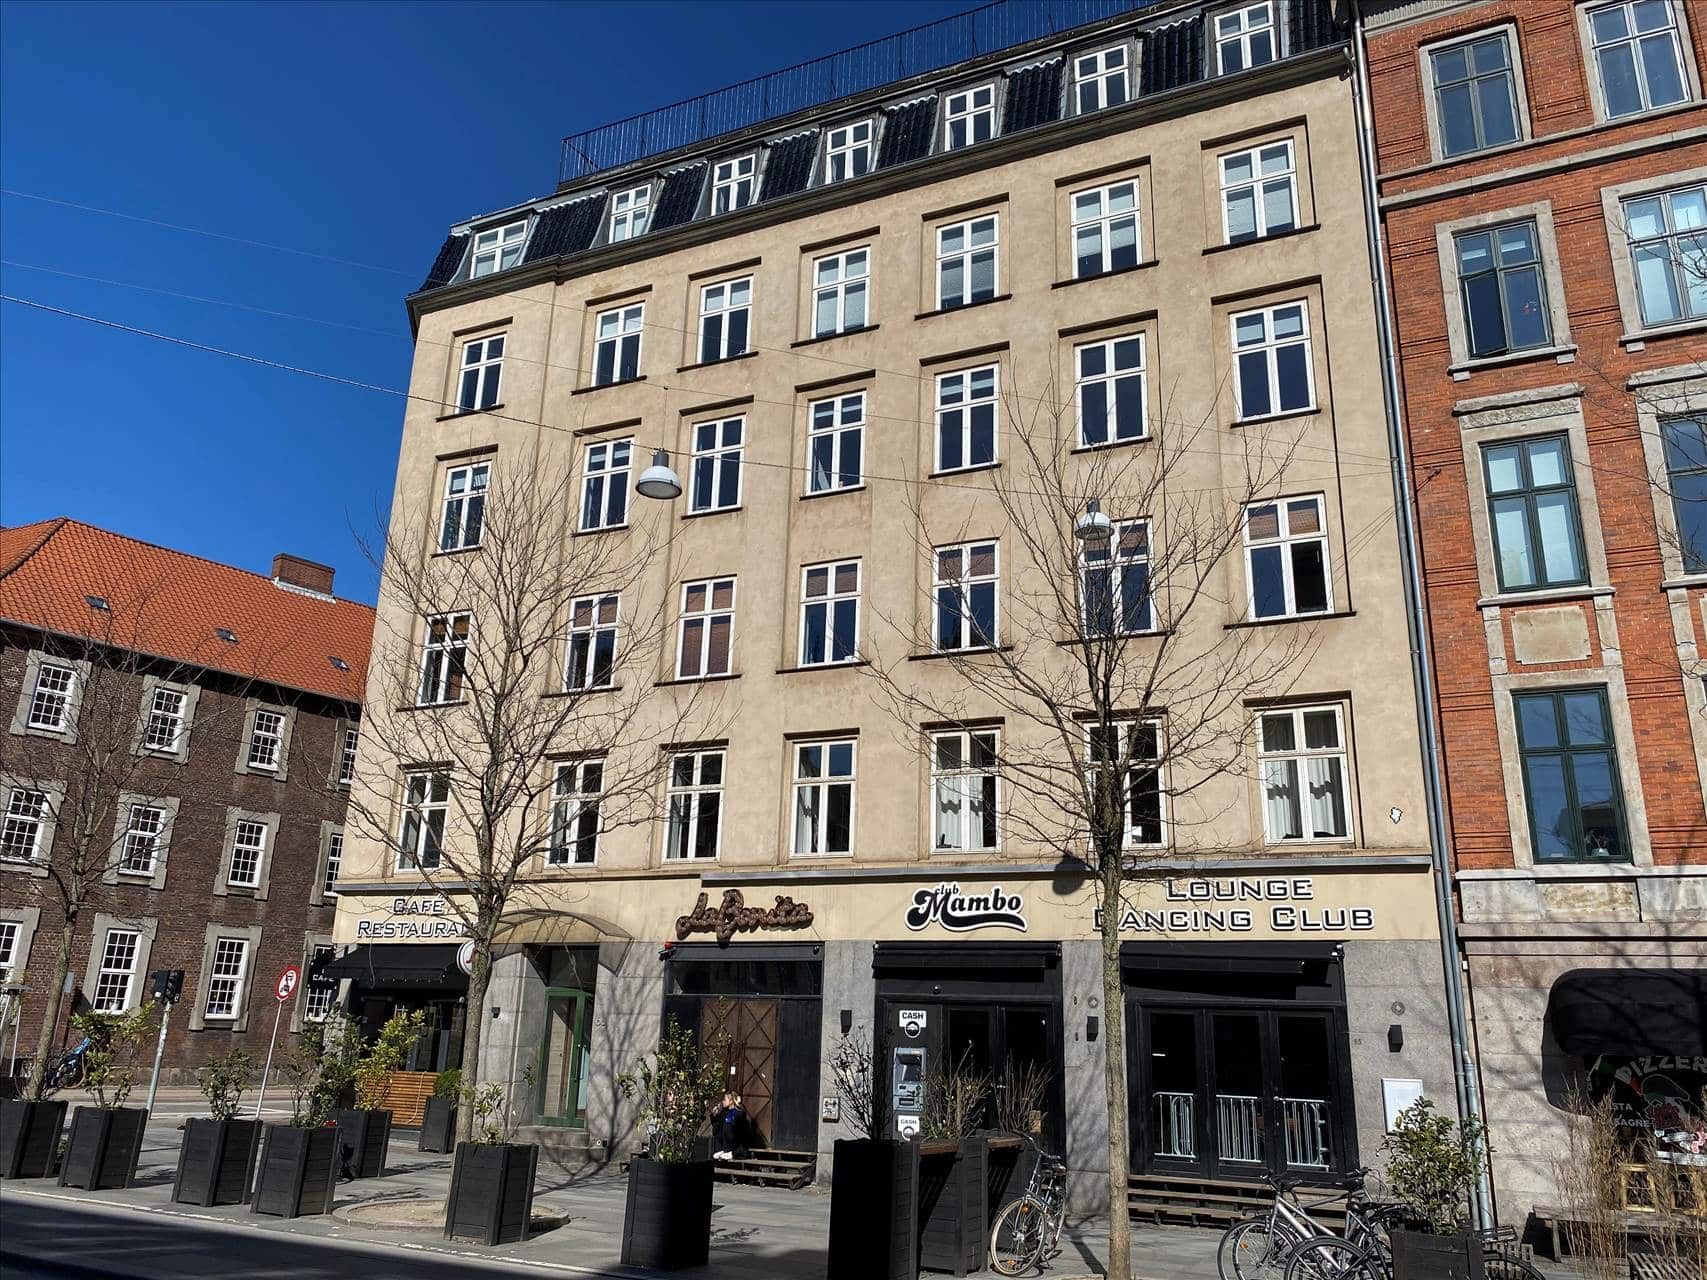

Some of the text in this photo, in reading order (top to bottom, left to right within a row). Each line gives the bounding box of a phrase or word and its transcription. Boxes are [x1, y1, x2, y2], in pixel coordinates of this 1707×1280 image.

[935, 882, 961, 896] club
[1166, 878, 1314, 901] LOUNGE
[392, 894, 446, 915] CAFÉ
[905, 887, 1027, 932] Mambo
[1270, 906, 1375, 931] CLUB
[902, 1011, 924, 1020] CASH
